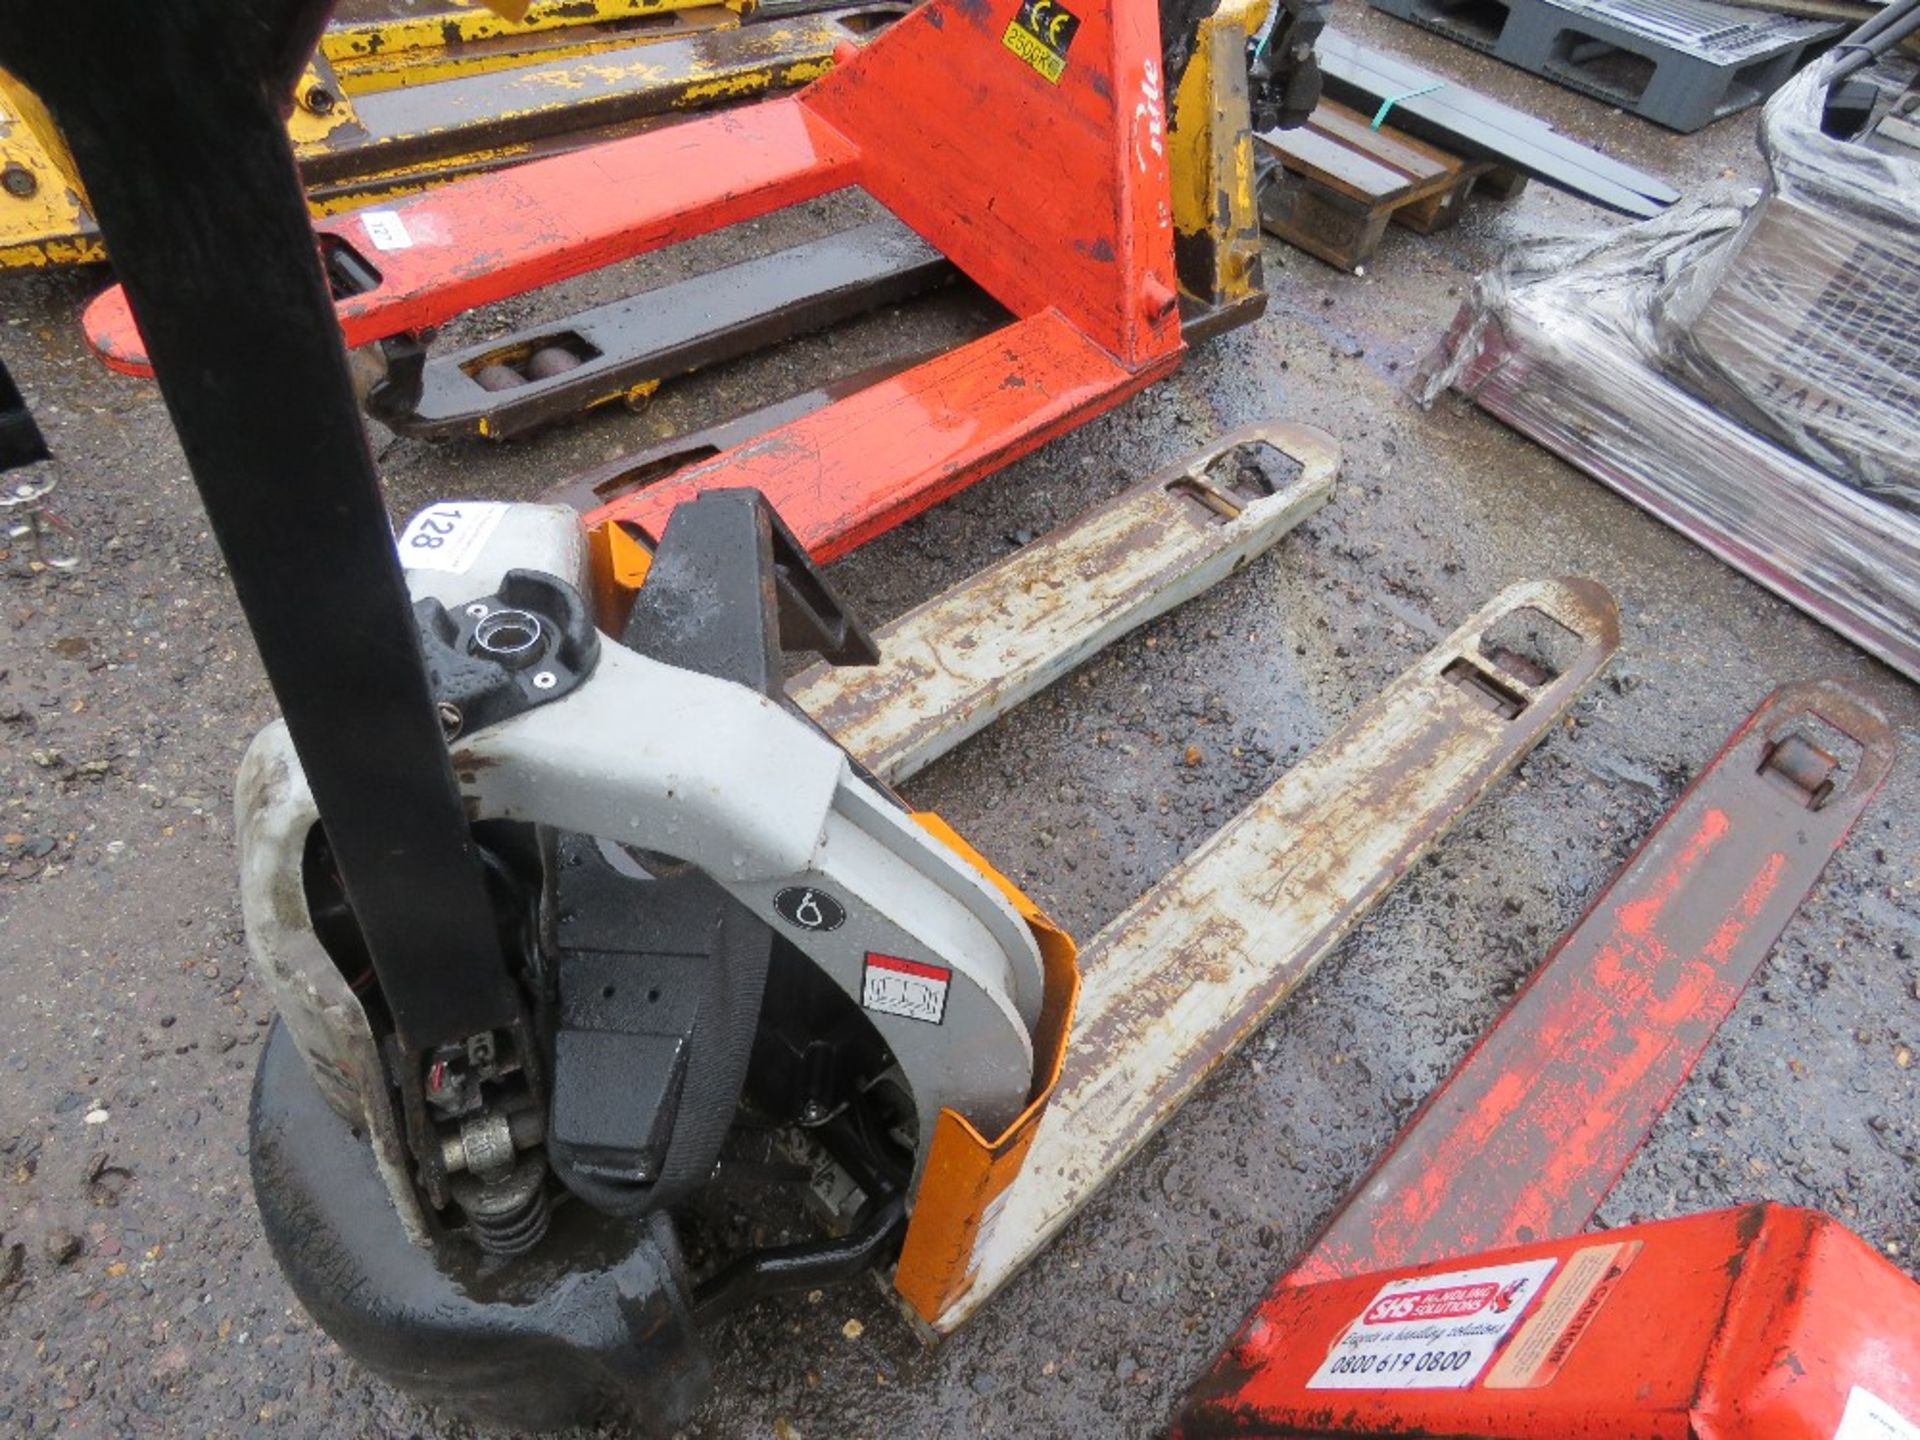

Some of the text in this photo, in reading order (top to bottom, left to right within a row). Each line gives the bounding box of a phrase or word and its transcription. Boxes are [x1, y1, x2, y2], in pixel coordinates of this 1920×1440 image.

[411, 510, 462, 550] 128
[1369, 1296, 1421, 1320] SHS
[1549, 1285, 1609, 1365] CAUTION
[1330, 1350, 1471, 1374] 0800 619 0800
